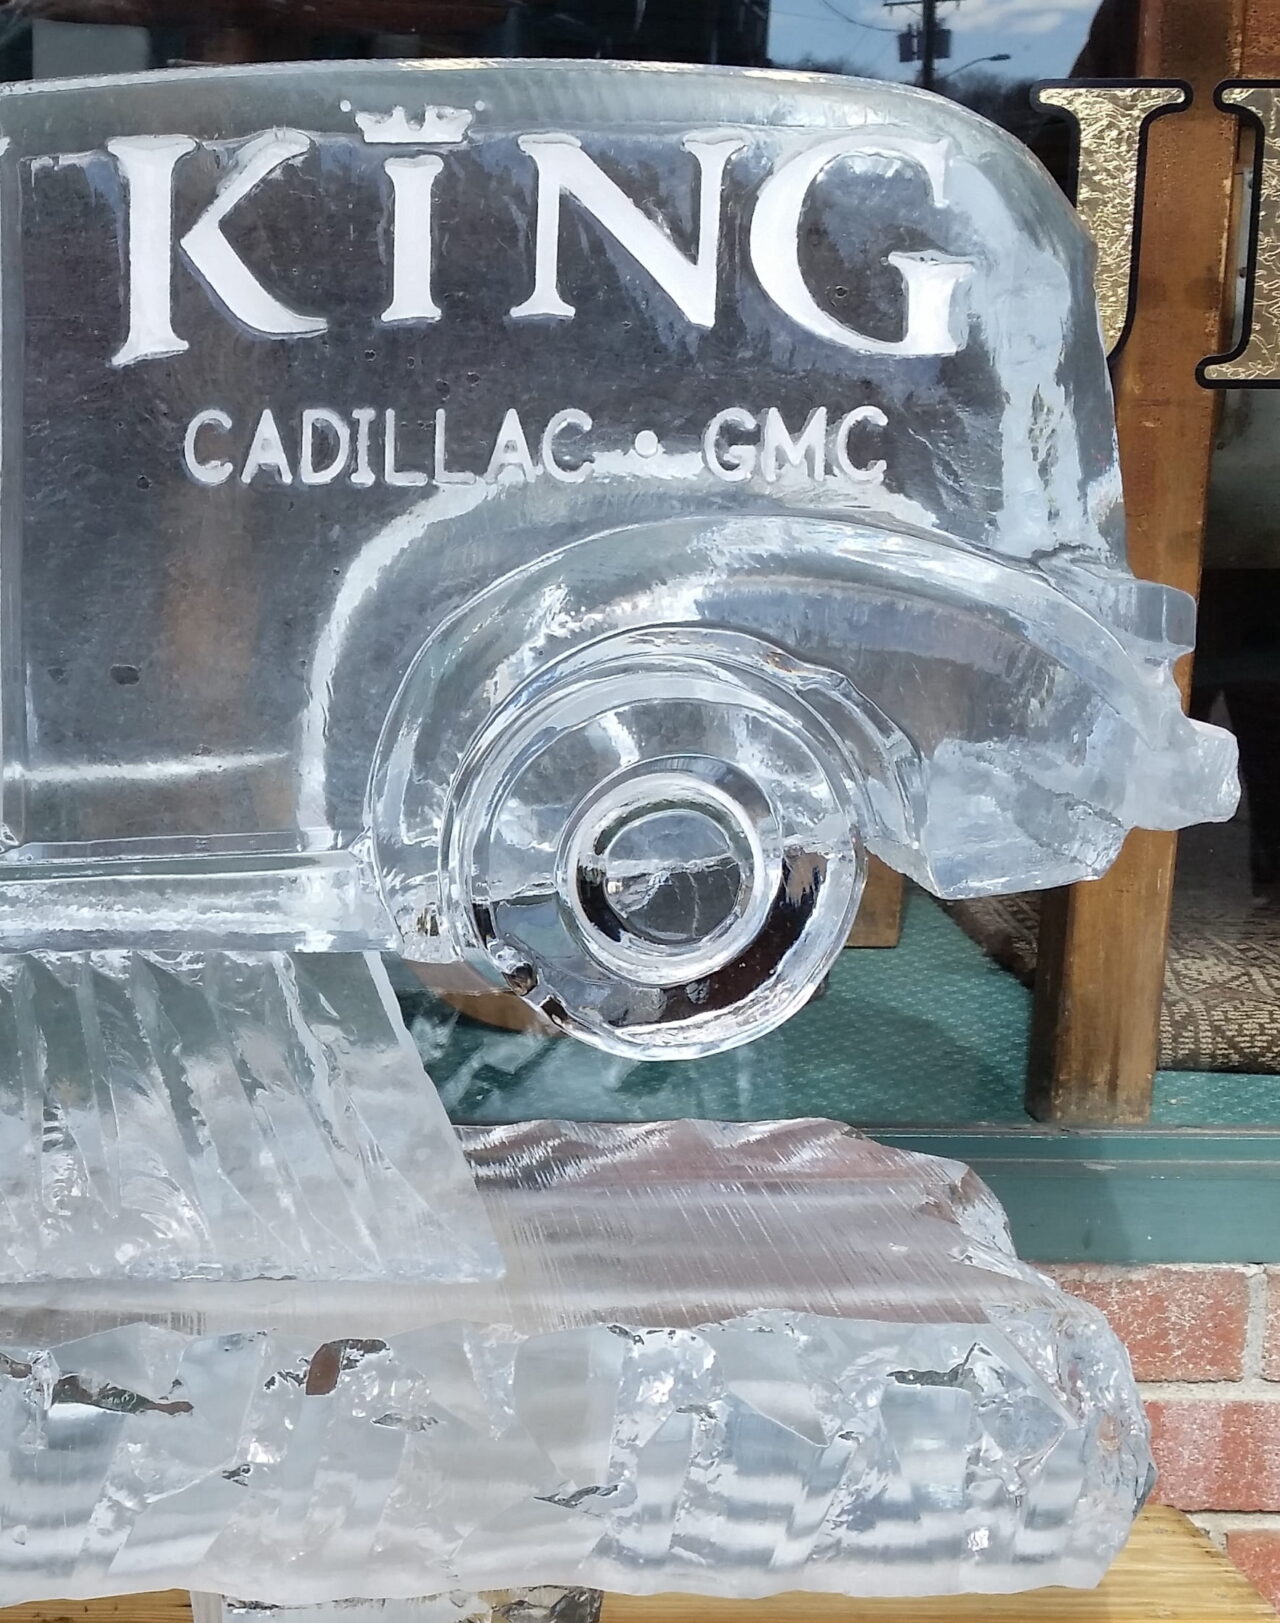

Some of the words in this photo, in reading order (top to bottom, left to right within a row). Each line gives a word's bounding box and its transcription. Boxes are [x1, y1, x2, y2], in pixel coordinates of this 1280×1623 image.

[105, 126, 976, 368] KING
[183, 406, 597, 488] CADILLAC
[702, 404, 890, 484] GMC
